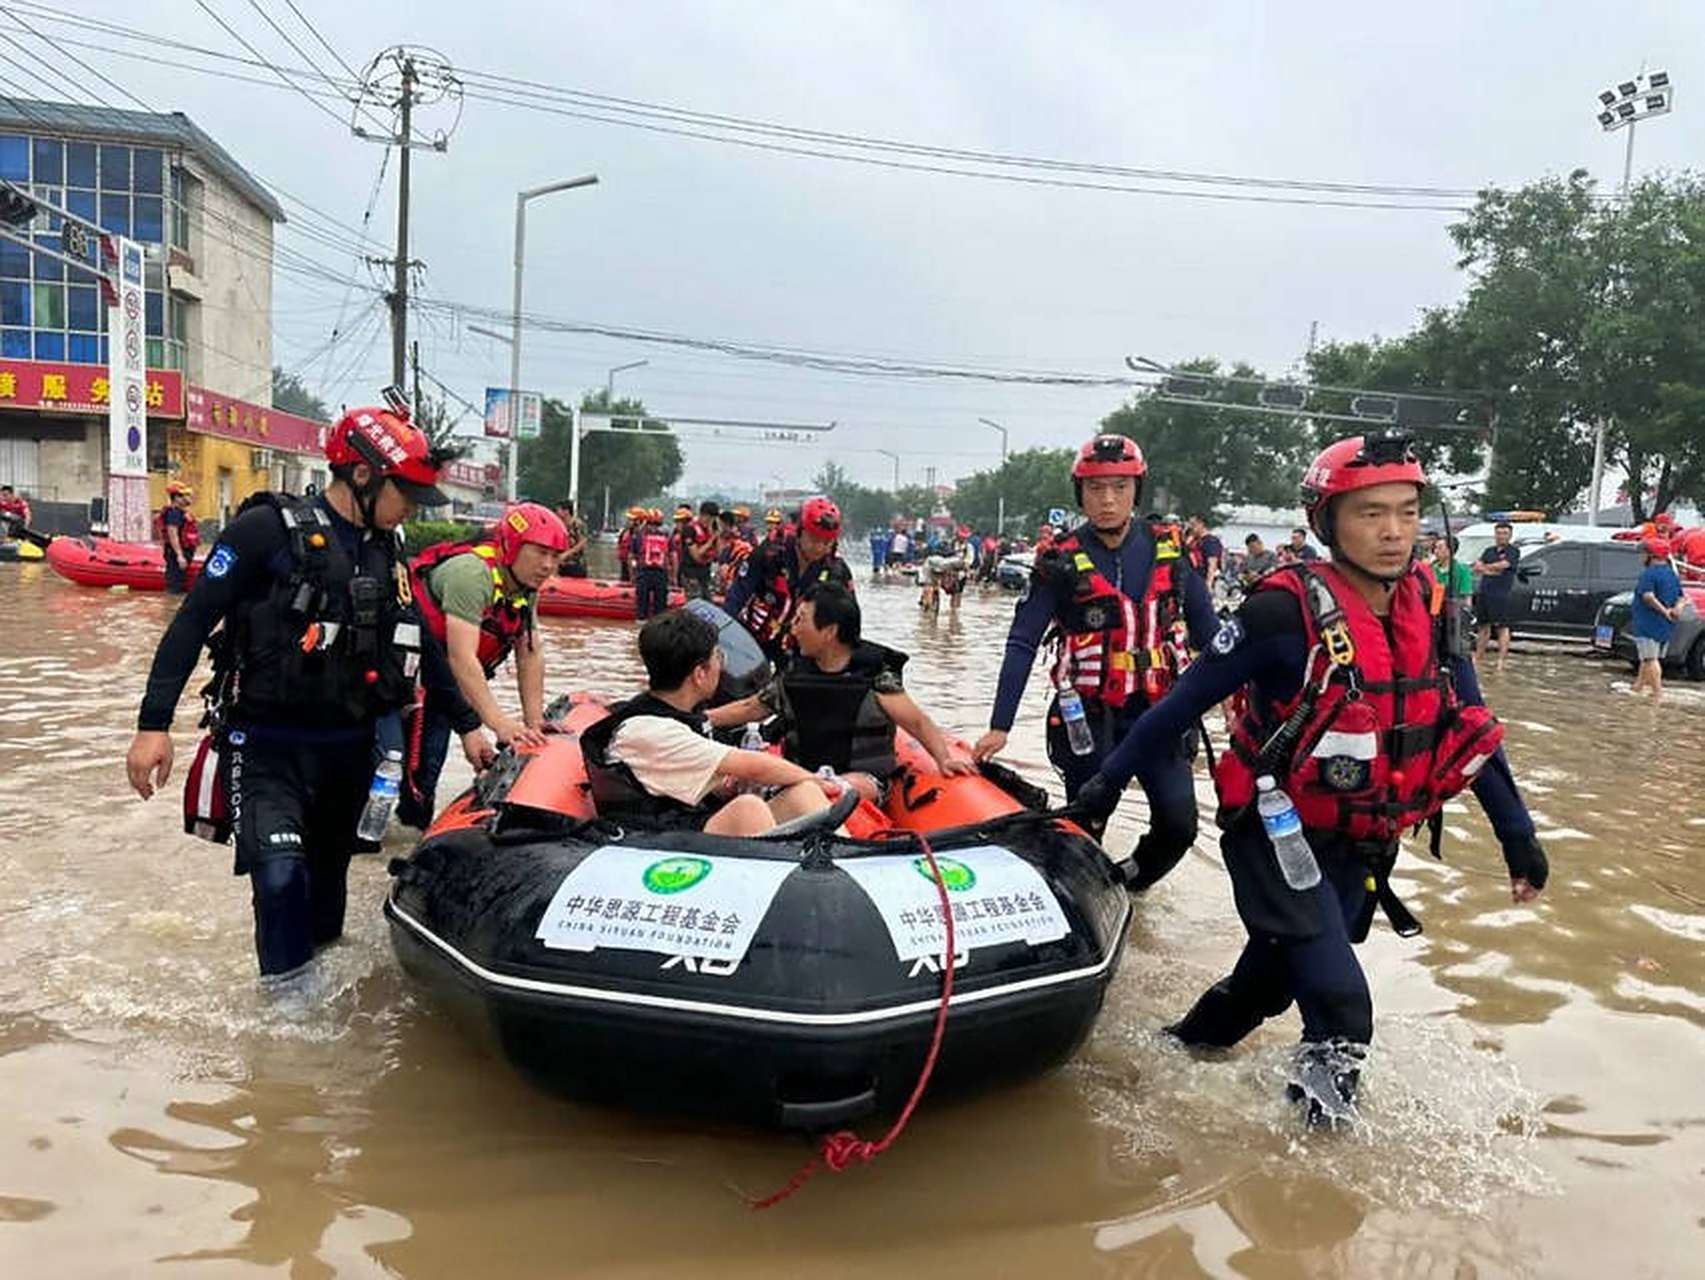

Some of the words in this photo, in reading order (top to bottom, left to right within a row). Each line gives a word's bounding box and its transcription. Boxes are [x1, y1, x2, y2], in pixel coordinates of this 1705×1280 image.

[566, 894, 741, 935] 中华思源工程基金会
[558, 920, 594, 932] CHINA
[599, 925, 645, 939] SIYUAN
[650, 930, 732, 950] FOUNDATION
